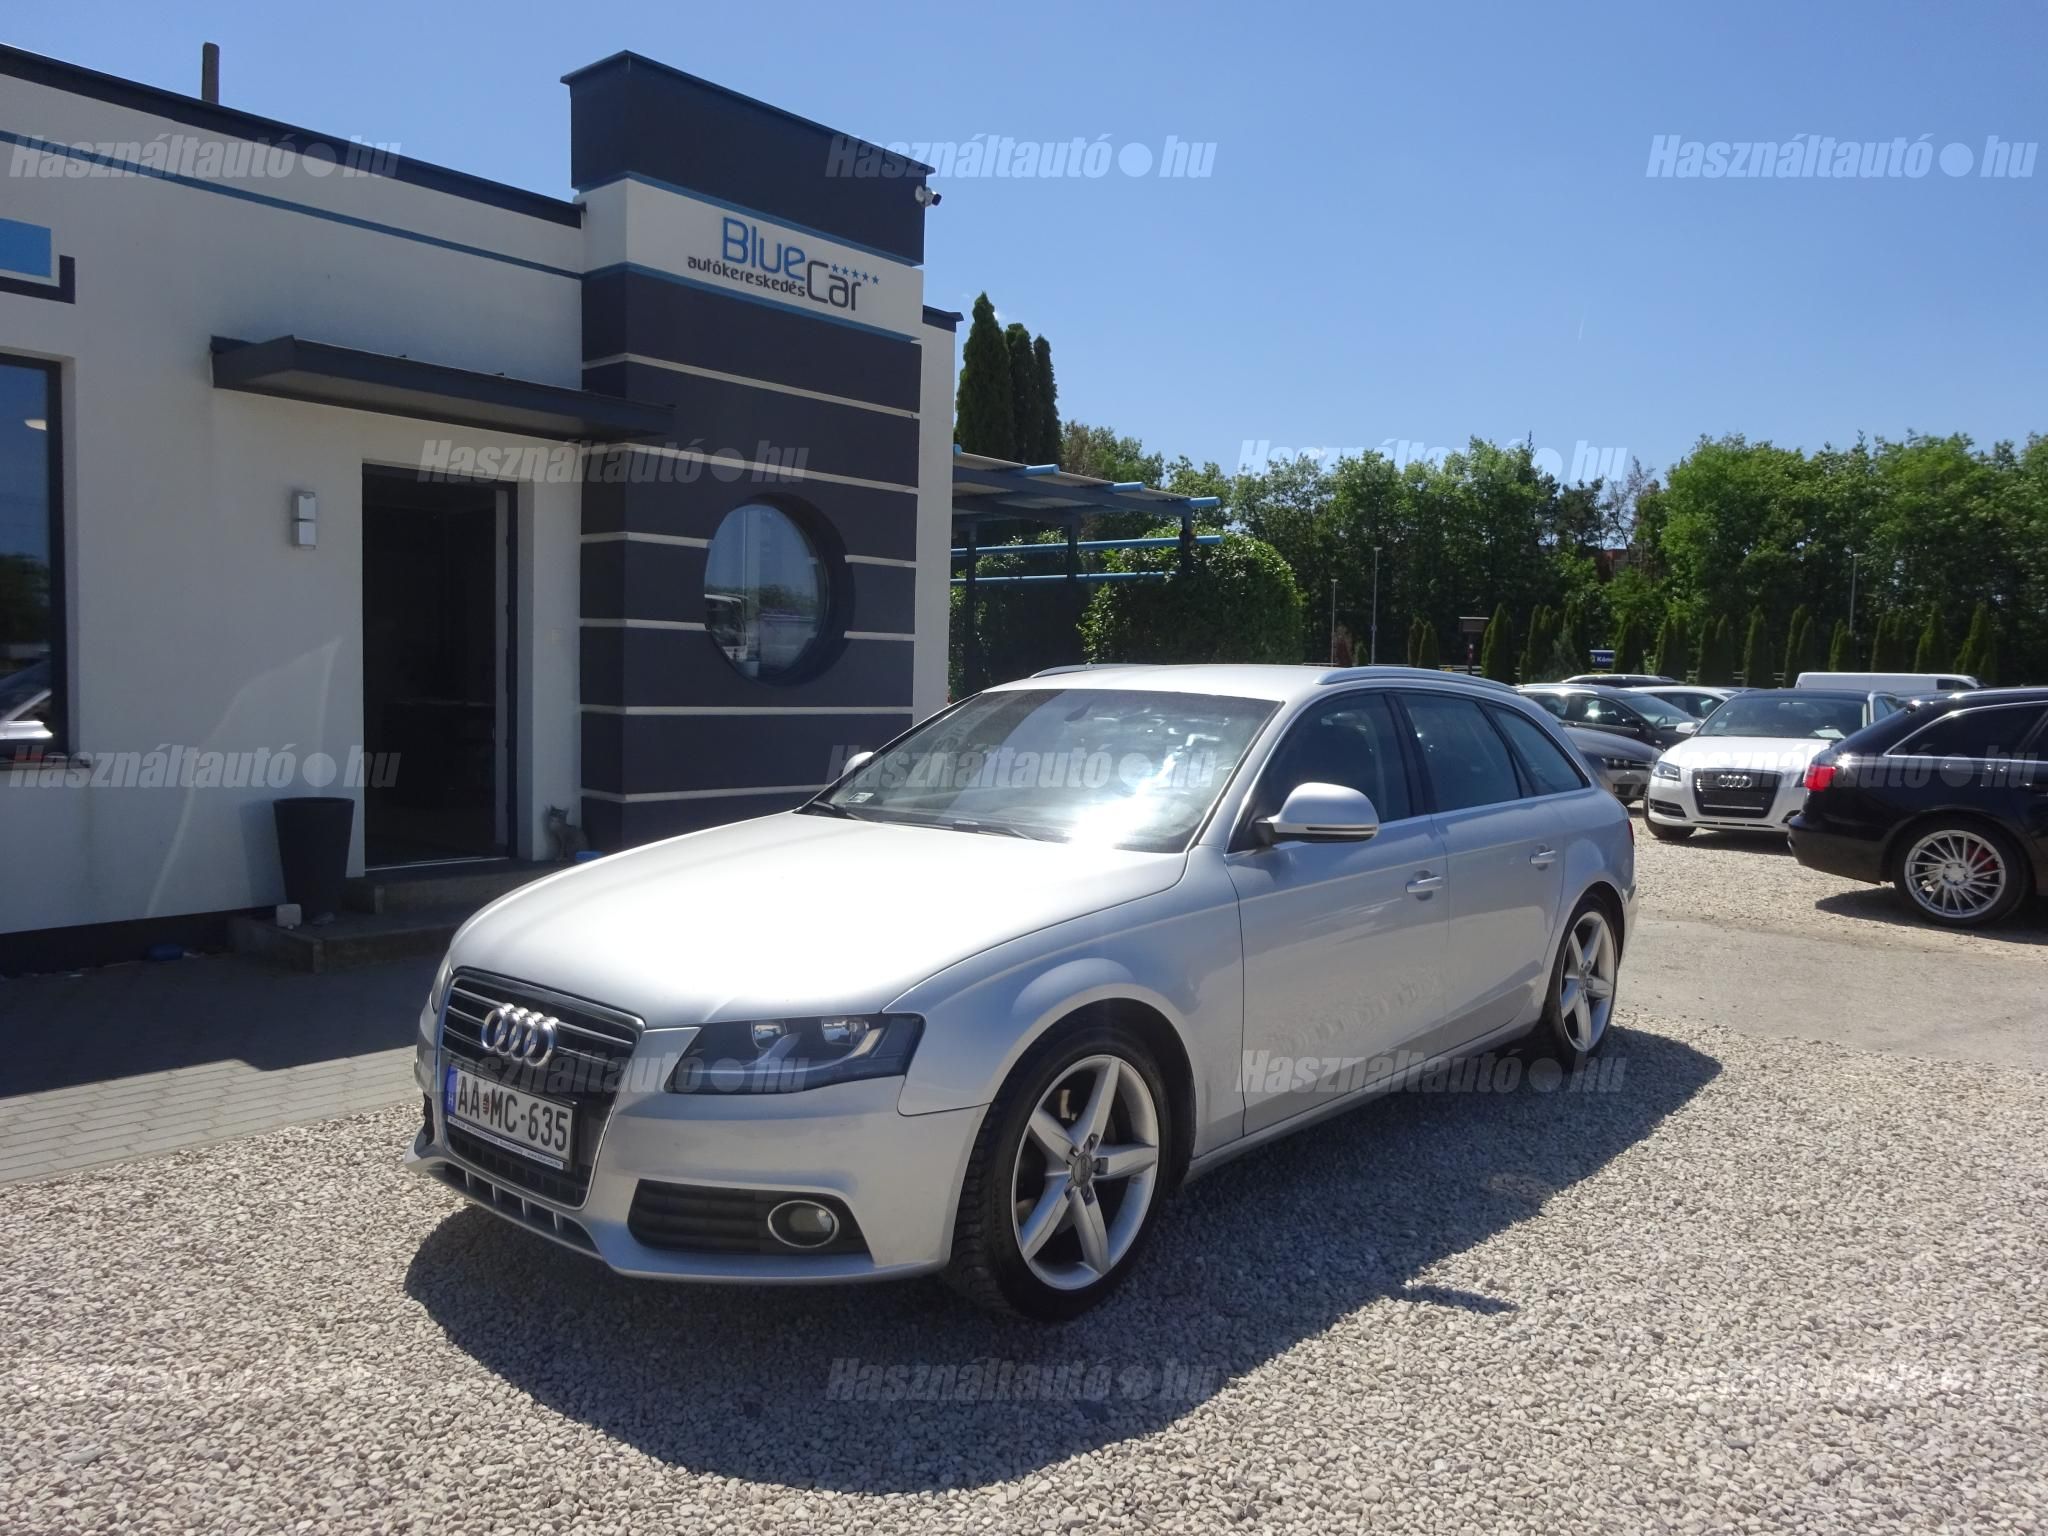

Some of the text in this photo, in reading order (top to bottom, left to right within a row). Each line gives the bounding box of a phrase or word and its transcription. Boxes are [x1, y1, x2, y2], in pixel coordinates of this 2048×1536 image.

[687, 256, 806, 298] autókereskedés
[457, 1075, 481, 1120] AA
[489, 1087, 569, 1152] MC-635
